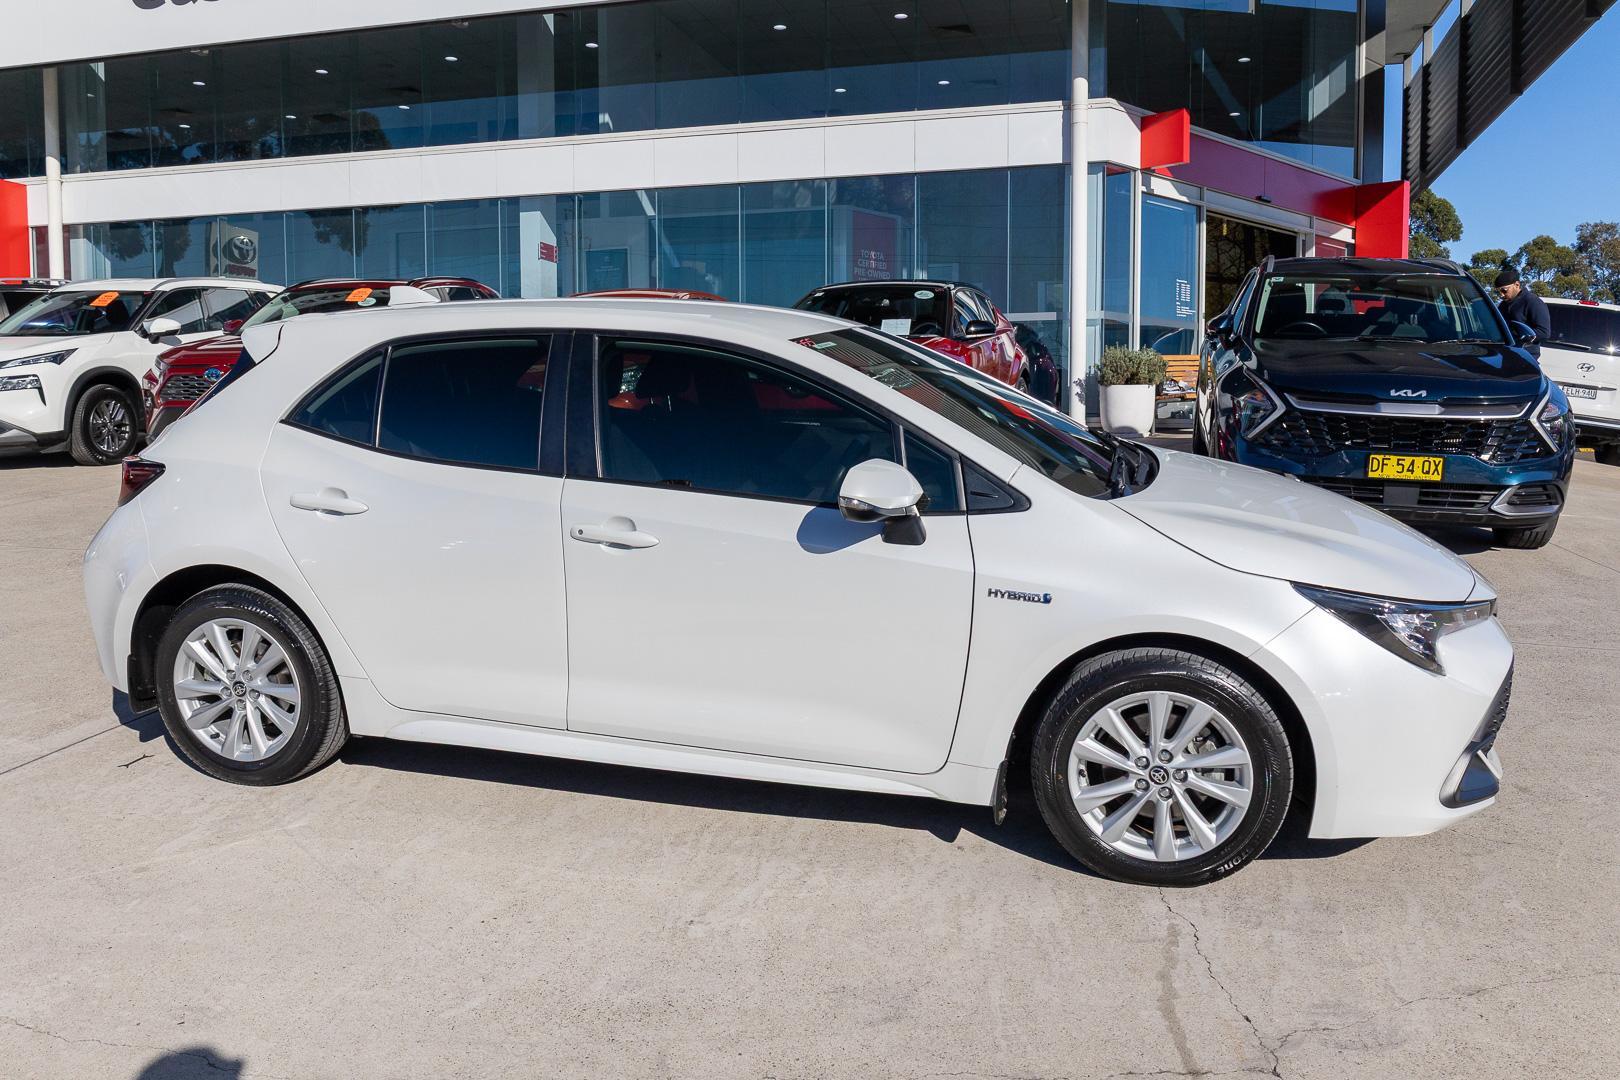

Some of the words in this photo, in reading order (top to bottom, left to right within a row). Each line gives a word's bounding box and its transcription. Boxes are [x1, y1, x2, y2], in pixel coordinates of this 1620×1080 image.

[861, 250, 885, 260] TOYOTA
[858, 259, 887, 270] CERTIFIED
[987, 588, 1042, 603] HYBRID
